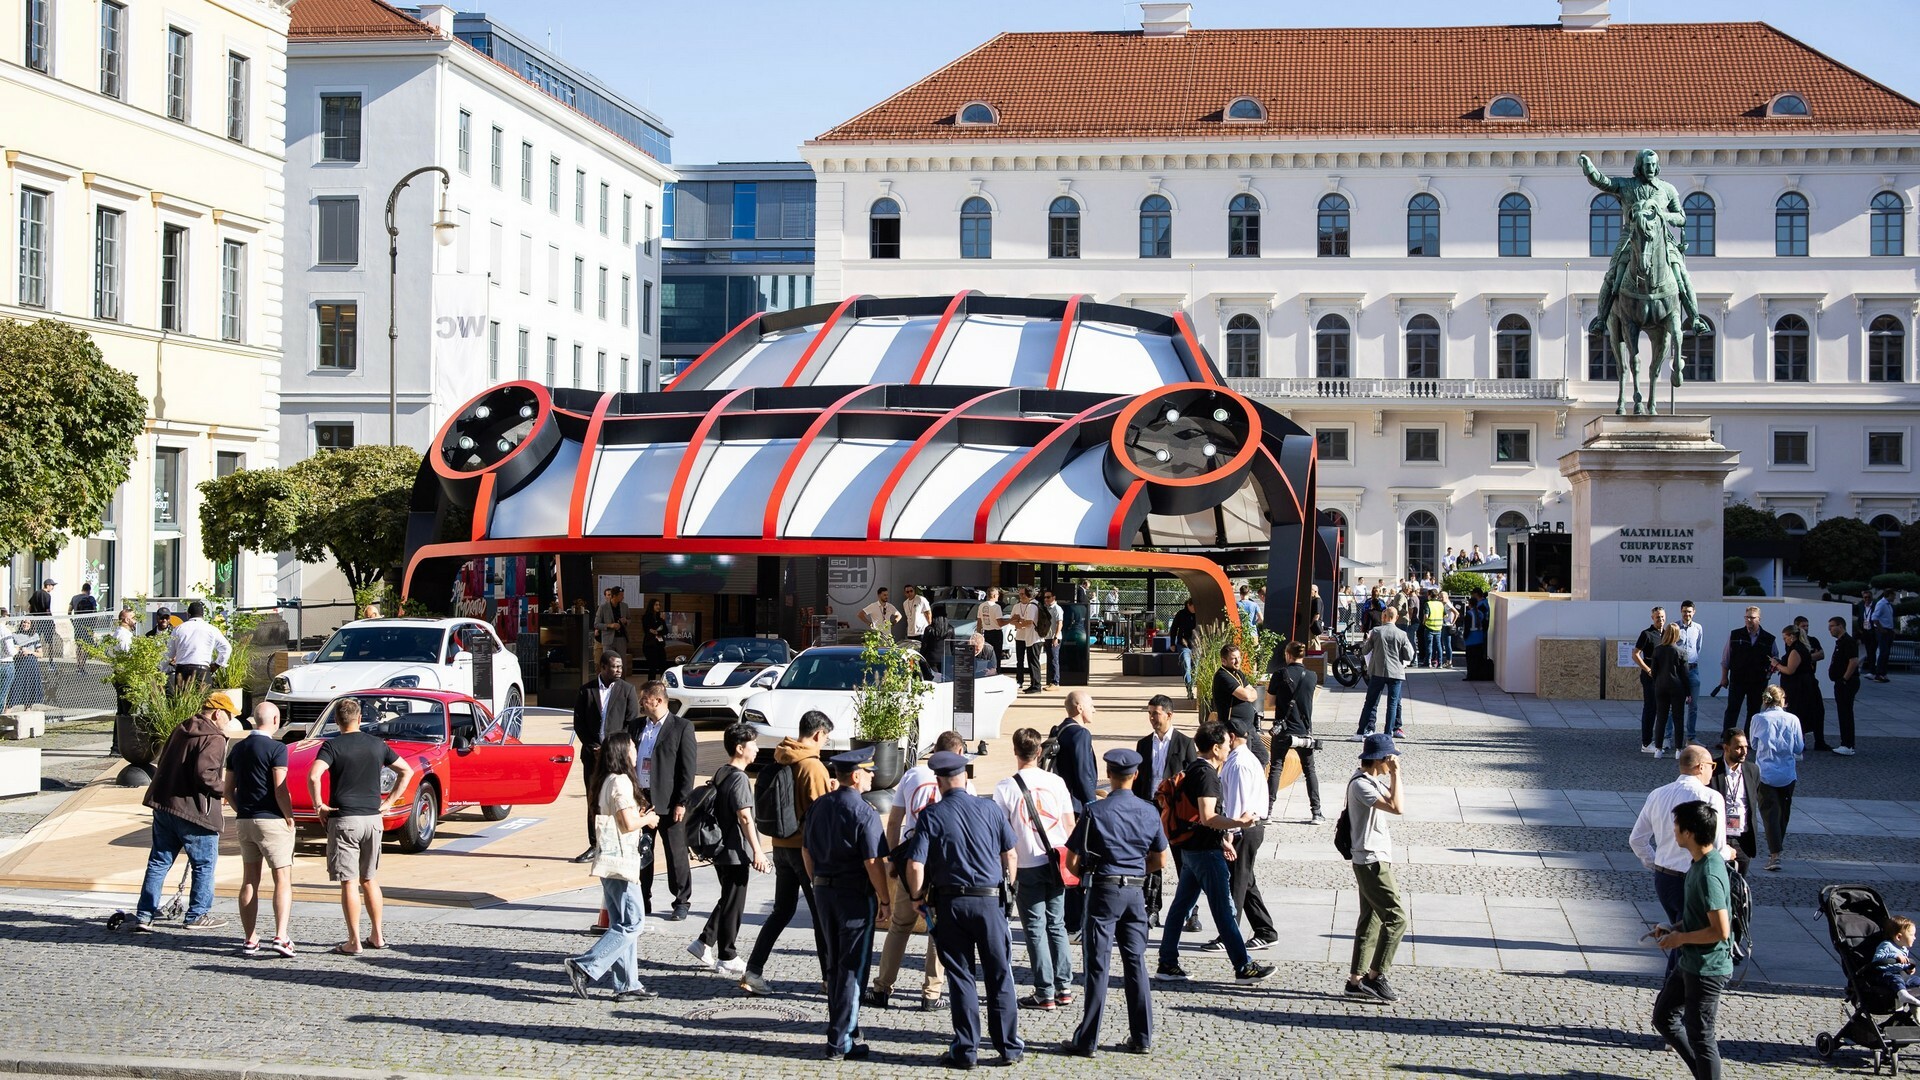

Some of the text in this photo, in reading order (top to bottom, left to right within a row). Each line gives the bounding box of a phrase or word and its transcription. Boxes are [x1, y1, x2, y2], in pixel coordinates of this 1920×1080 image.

[1619, 528, 1695, 538] MAXIMILIAN
[1619, 541, 1695, 551] CHURFUERST
[1619, 554, 1694, 564] VON BAYERN
[828, 569, 868, 583] 911
